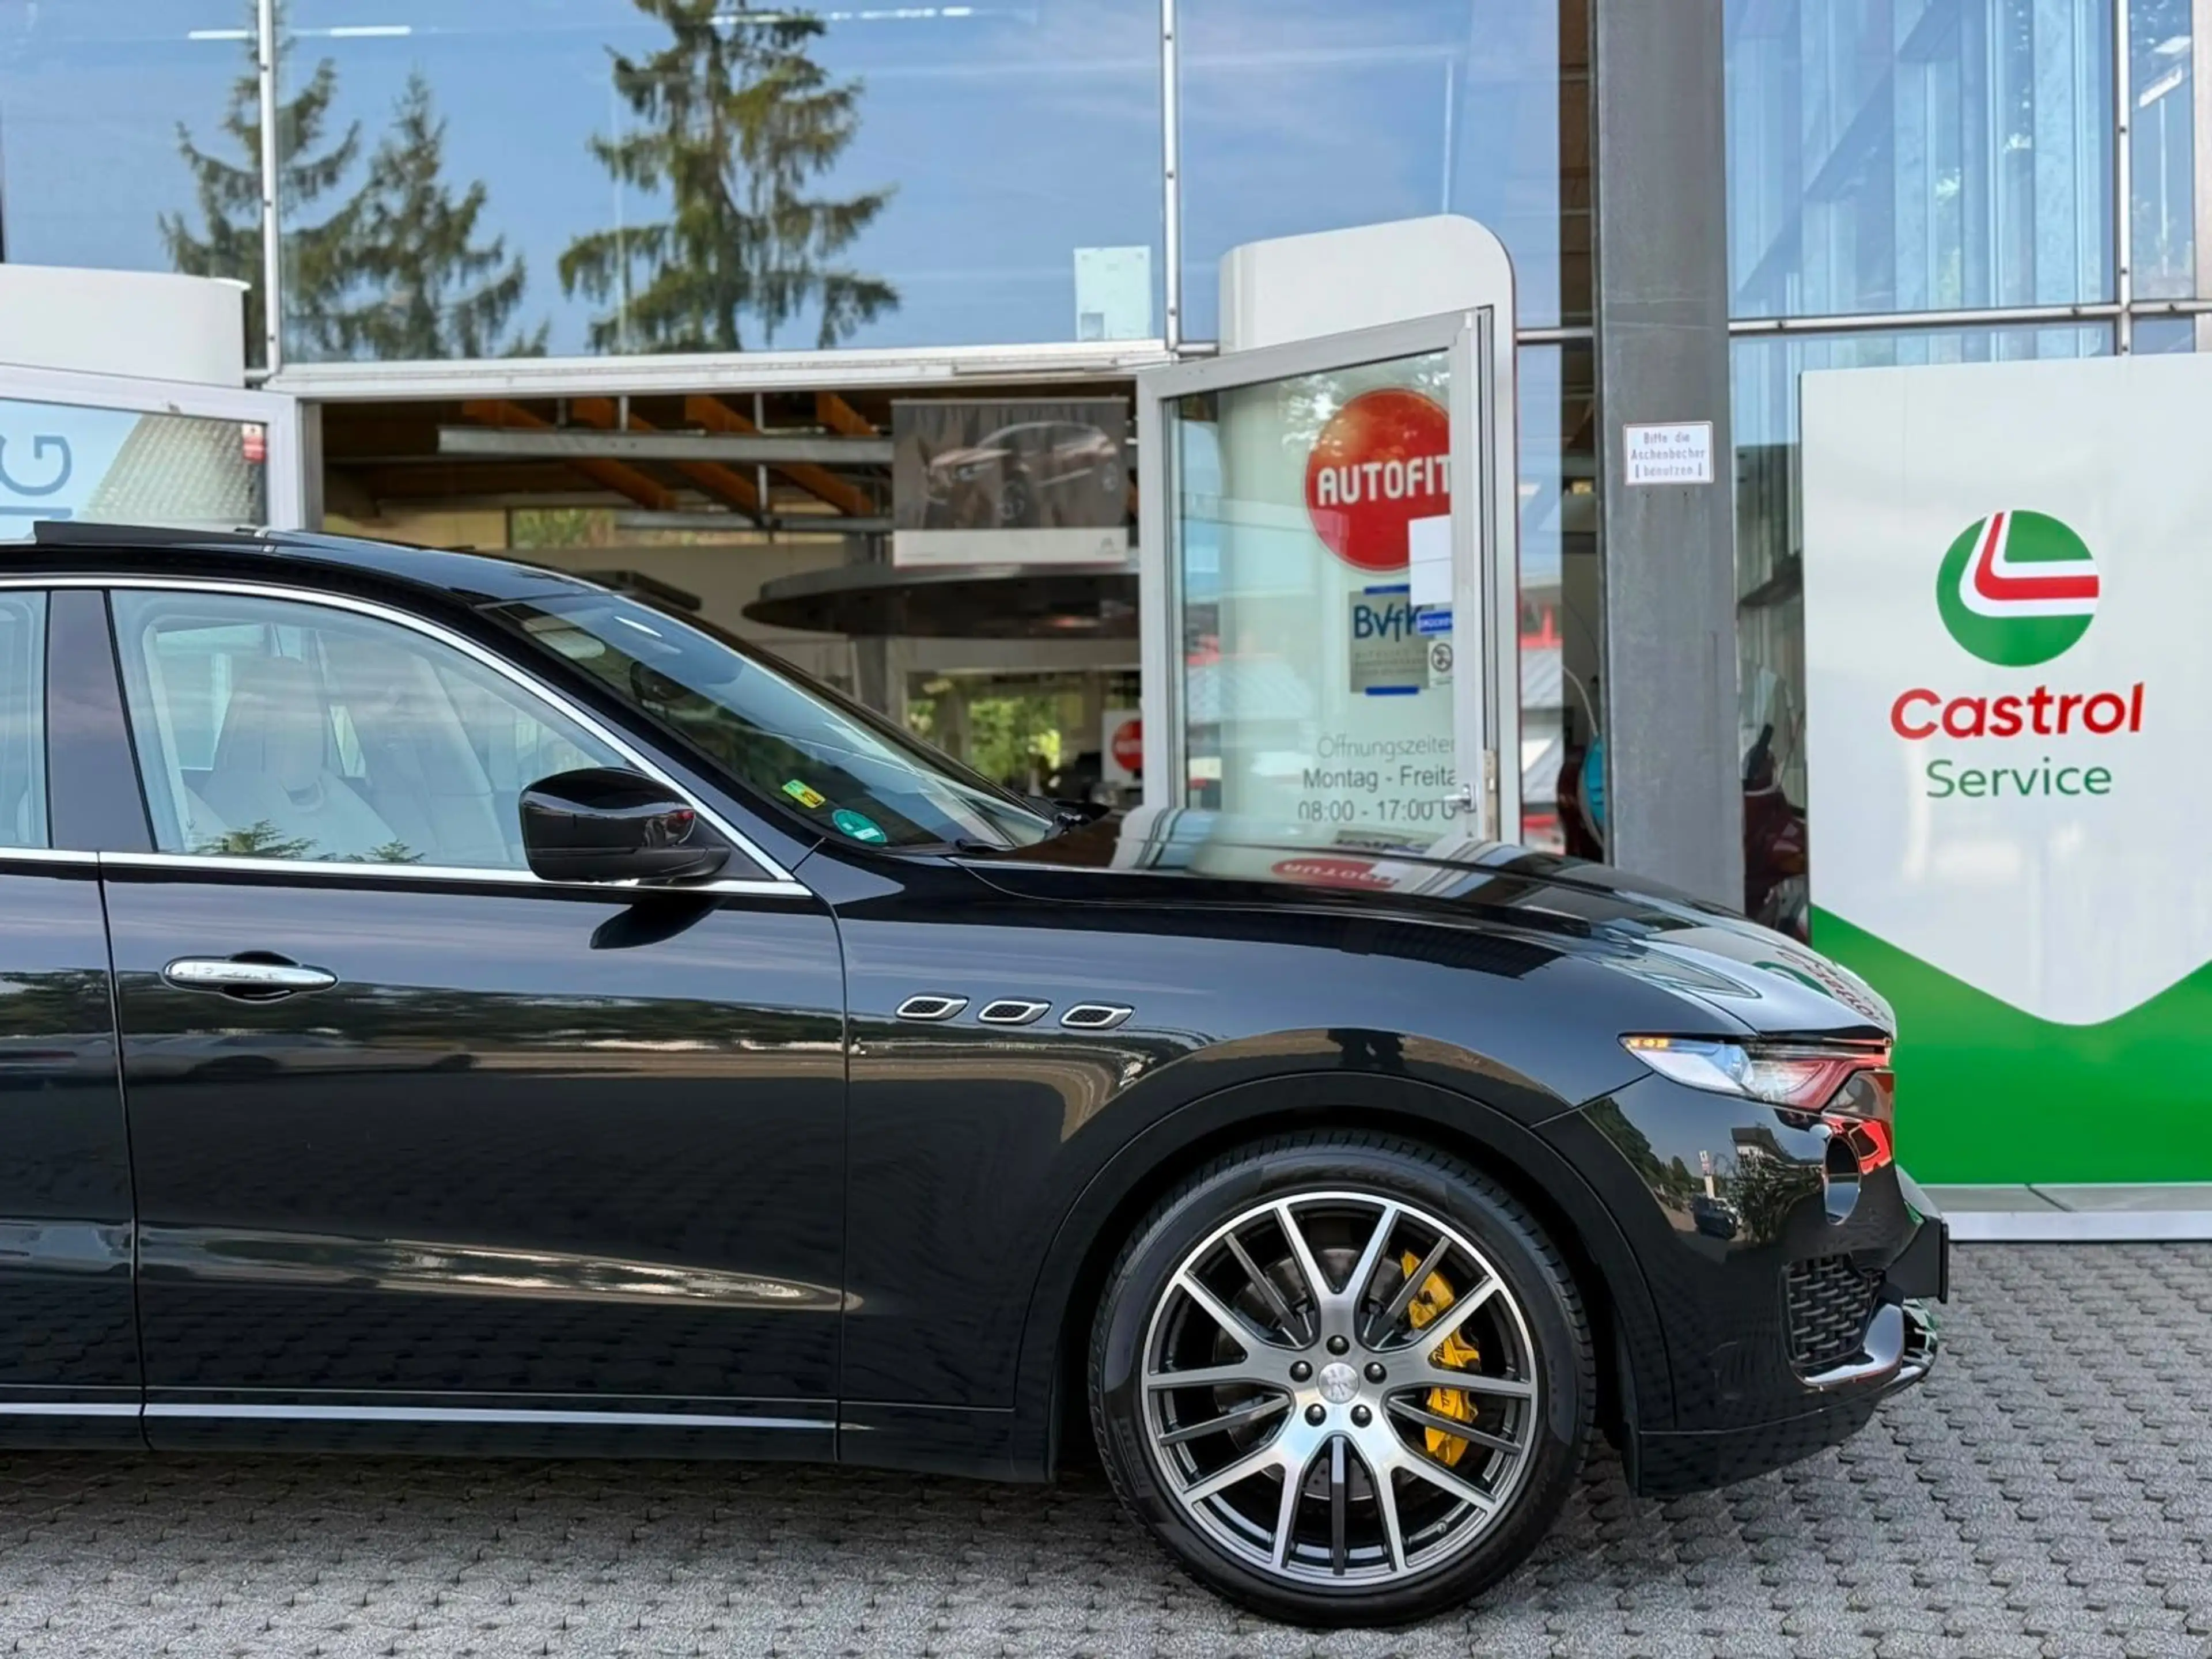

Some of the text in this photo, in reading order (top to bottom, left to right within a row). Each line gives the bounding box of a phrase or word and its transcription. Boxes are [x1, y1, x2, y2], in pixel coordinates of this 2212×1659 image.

[1317, 454, 1450, 506] AUTOFIT
[1891, 682, 2145, 740] Castrol
[1302, 767, 1379, 794] Montag
[1926, 756, 2112, 798] Service
[1298, 800, 1354, 821] 08:00
[1377, 798, 1434, 821] 17:00
